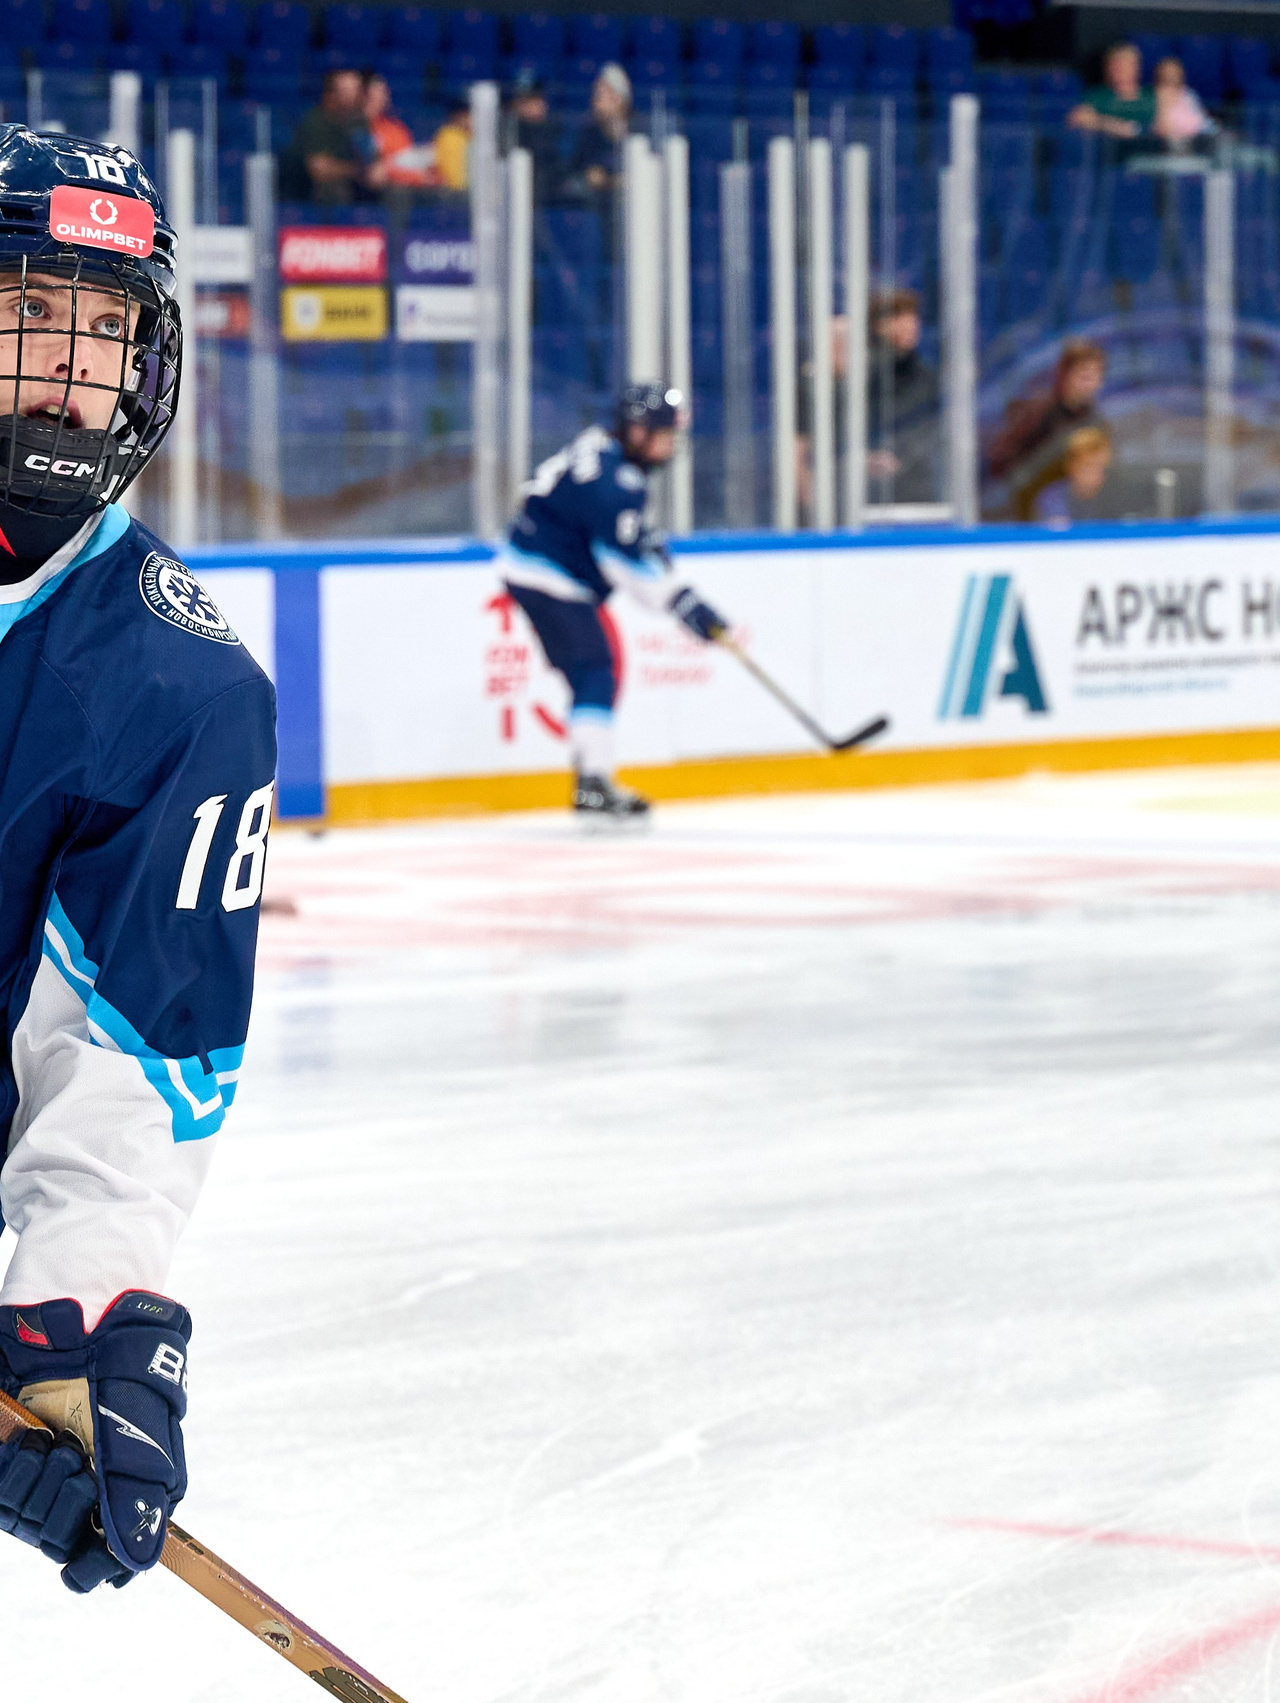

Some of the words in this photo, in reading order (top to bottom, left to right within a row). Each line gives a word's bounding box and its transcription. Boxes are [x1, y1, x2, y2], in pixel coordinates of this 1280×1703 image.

[55, 223, 147, 251] OLIMPBET
[24, 454, 103, 482] CCM
[1075, 578, 1225, 645] АРЖС
[175, 780, 274, 912] 18
